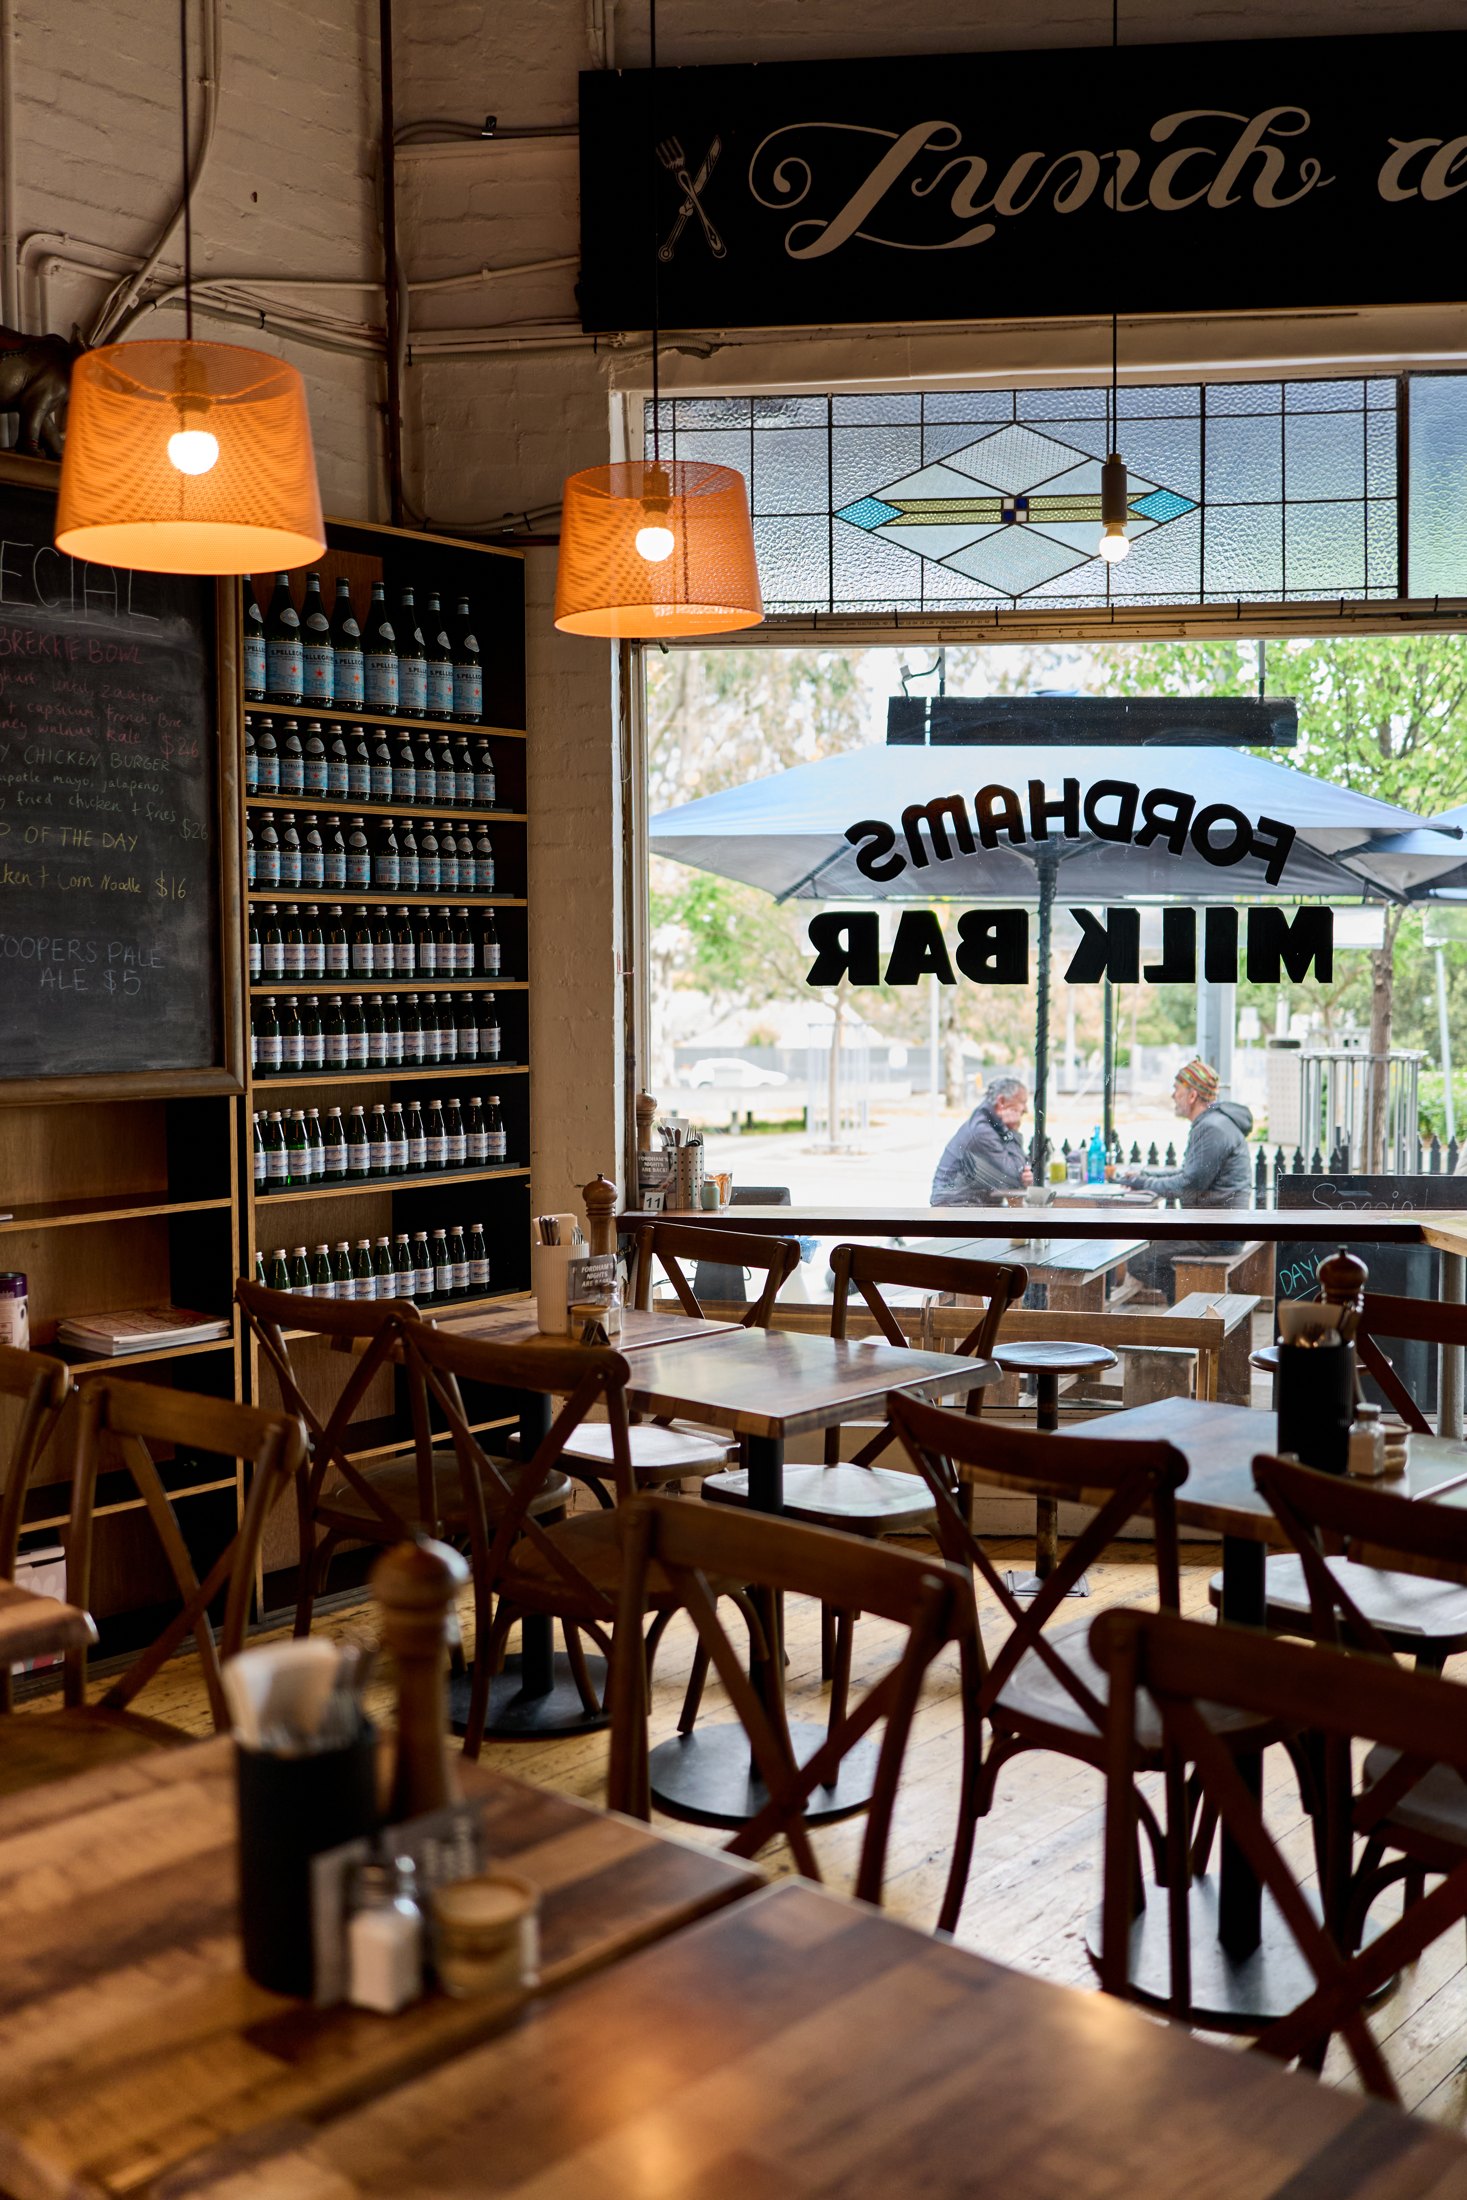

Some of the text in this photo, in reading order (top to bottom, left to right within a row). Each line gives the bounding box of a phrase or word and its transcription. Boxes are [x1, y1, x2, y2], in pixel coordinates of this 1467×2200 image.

[749, 106, 1336, 259] Lunch
[88, 639, 144, 666] BOWL
[24, 744, 101, 767] CHICKEN
[110, 752, 170, 771] BURGER
[17, 790, 53, 806] fried
[68, 792, 122, 812] chicken
[145, 801, 177, 822] fries
[25, 826, 52, 844] OF
[60, 826, 94, 848] THE
[102, 832, 138, 852] DAY
[180, 818, 208, 840] $26
[0, 863, 32, 886] ken
[101, 874, 142, 893] Noodle
[154, 870, 186, 900] $16
[108, 942, 165, 969] PALE
[40, 967, 89, 991] ALE
[646, 1197, 661, 1209] 11
[586, 1271, 608, 1279] NIGHTS
